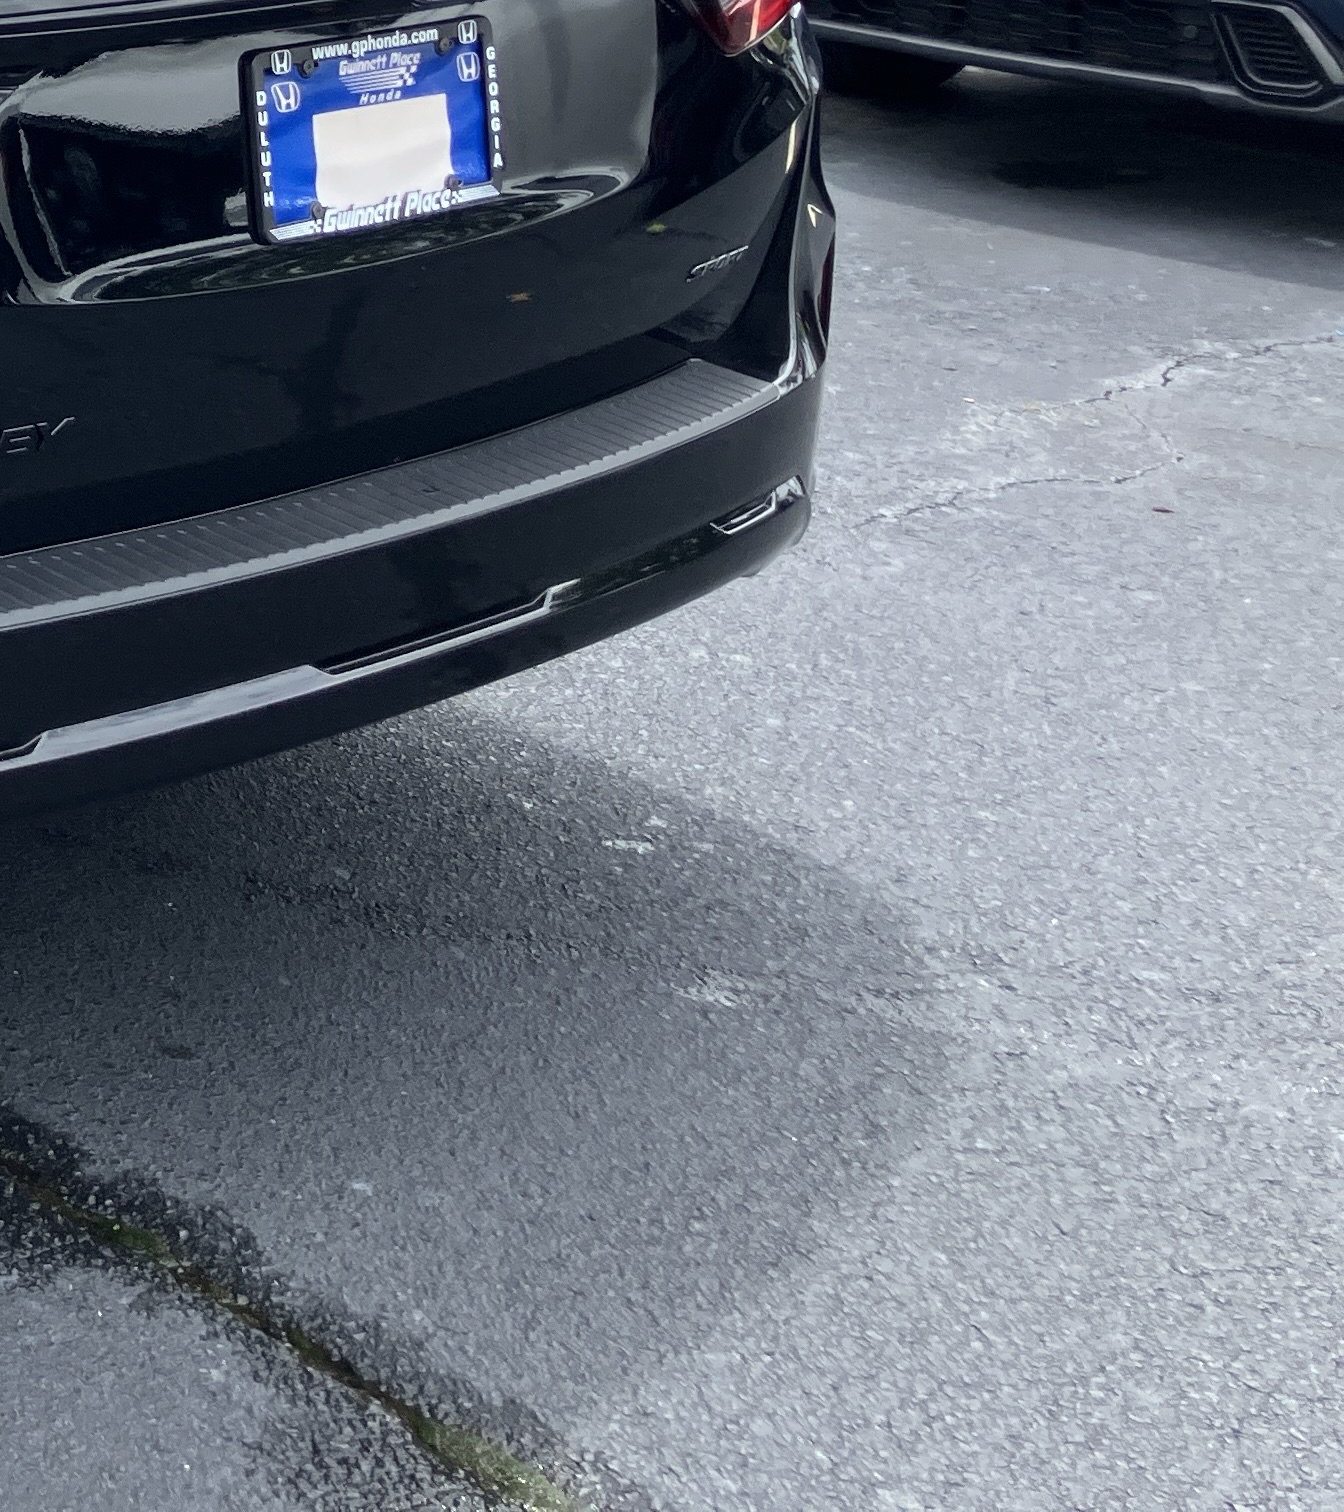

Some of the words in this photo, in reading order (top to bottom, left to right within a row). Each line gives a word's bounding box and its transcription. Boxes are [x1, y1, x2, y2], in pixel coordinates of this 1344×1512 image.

[312, 28, 439, 59] www.gphonda.com
[339, 54, 387, 75] Gwinnett
[389, 52, 421, 68] Place
[359, 89, 401, 105] Honda
[486, 46, 503, 169] GEORGIA
[256, 90, 274, 208] DULUTH
[323, 194, 401, 233] Gwinnett
[404, 188, 452, 217] Place
